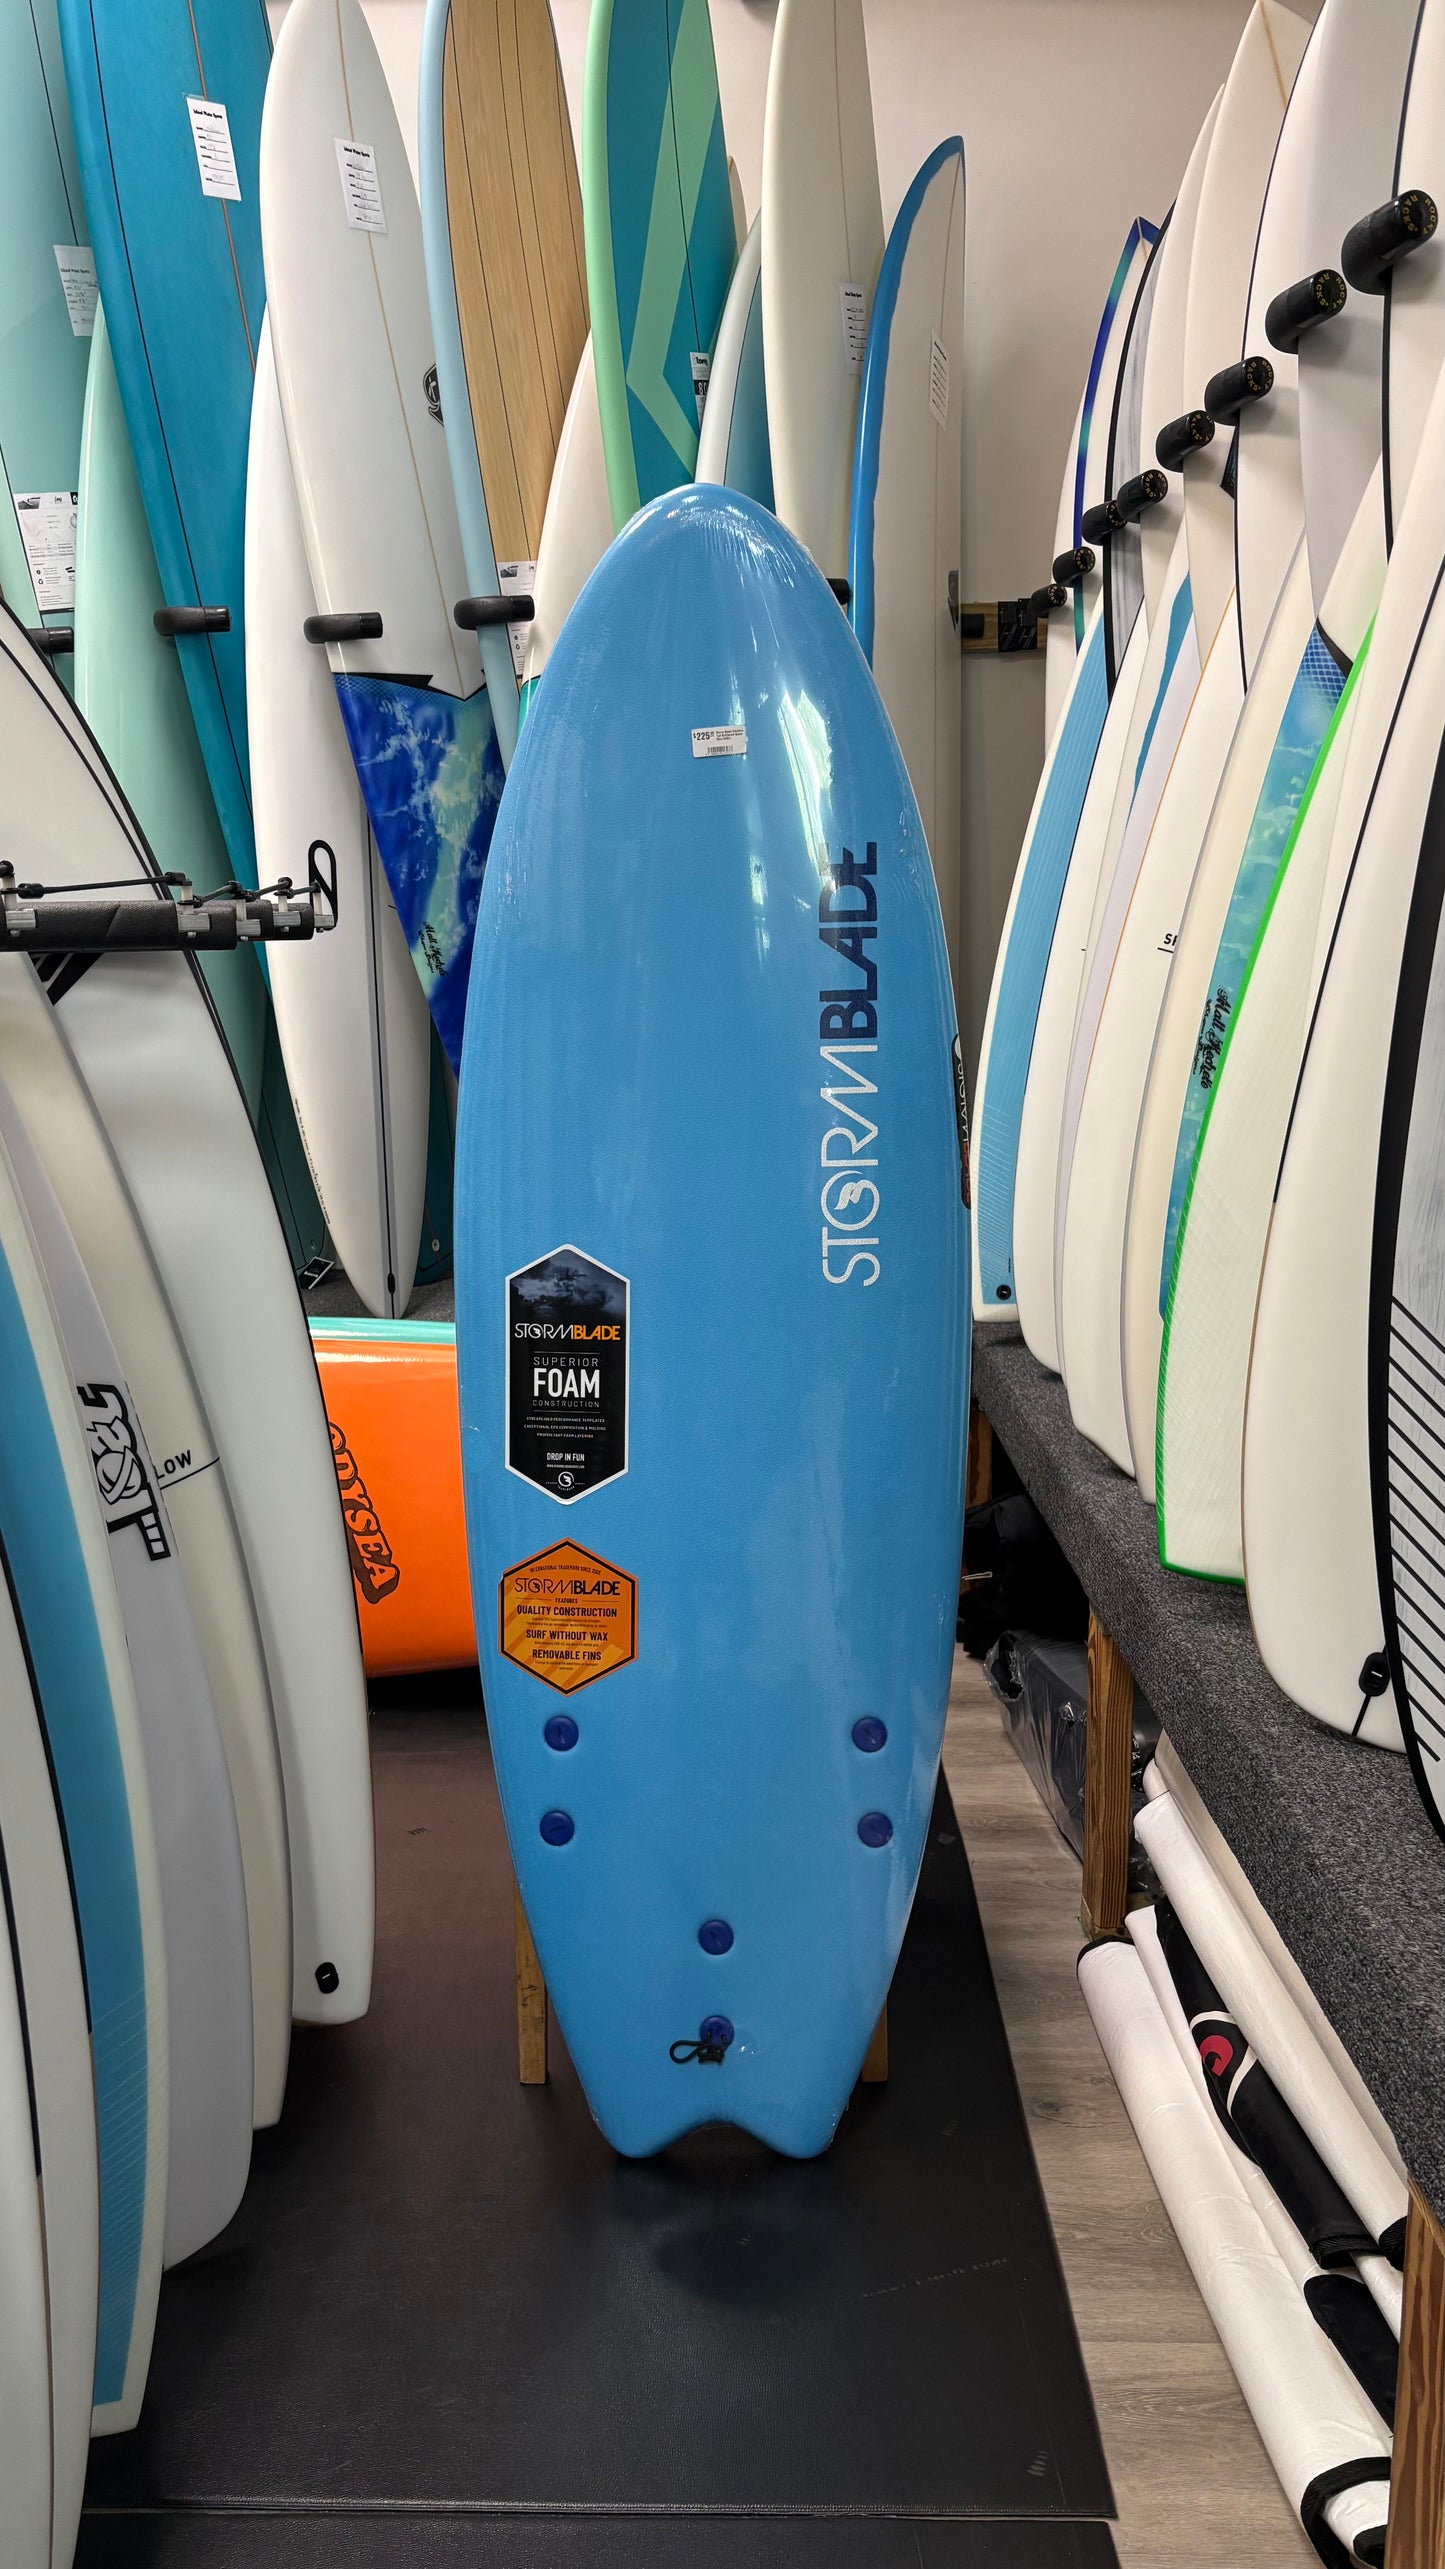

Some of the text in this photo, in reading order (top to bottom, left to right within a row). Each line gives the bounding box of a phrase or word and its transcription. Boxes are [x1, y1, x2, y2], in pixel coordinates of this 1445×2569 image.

[818, 841, 881, 1288] STORMBLADE
[514, 1323, 621, 1341] STORMBLADE
[533, 1356, 599, 1367] SUPERIOR
[533, 1367, 600, 1399] FOAM
[532, 1399, 600, 1408] CONSTRUCTION
[546, 1452, 585, 1462] DROP IN FUN
[514, 1577, 621, 1596] STORMBLADE
[516, 1605, 617, 1617] QUALITY CONSTRUCTION
[526, 1629, 608, 1641] SURF WITHOUT WAX
[532, 1649, 602, 1661] REMOVABLE FINS
